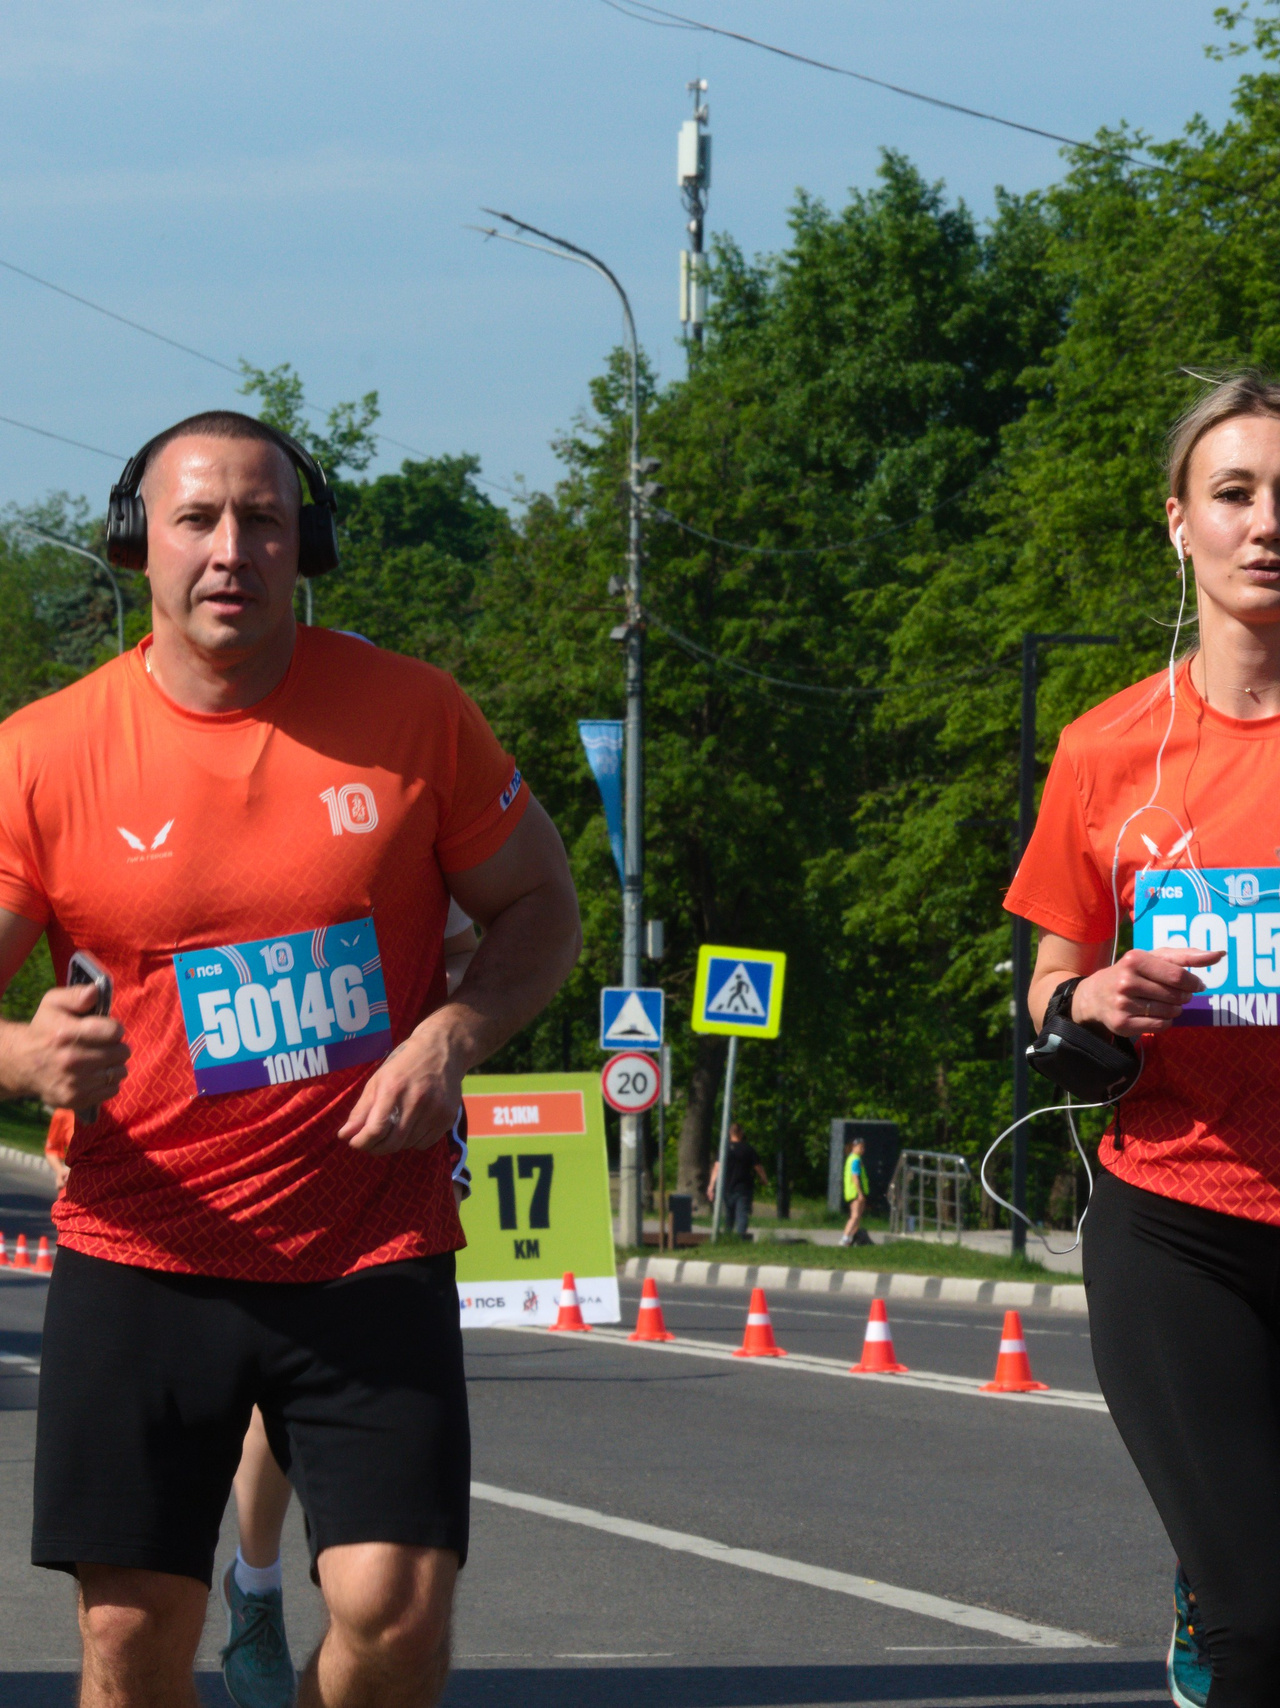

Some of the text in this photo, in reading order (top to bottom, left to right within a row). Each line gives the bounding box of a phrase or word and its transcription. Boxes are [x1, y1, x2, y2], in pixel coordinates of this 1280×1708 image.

[319, 783, 379, 836] 10
[1156, 886, 1183, 899] ПСБ
[1223, 873, 1260, 907] 10
[196, 963, 223, 978] ПСБ
[259, 941, 295, 976] 10
[198, 964, 371, 1060] 50146
[617, 1072, 648, 1095] 20
[487, 1153, 554, 1230] 17
[475, 1297, 506, 1309] ПСБ
